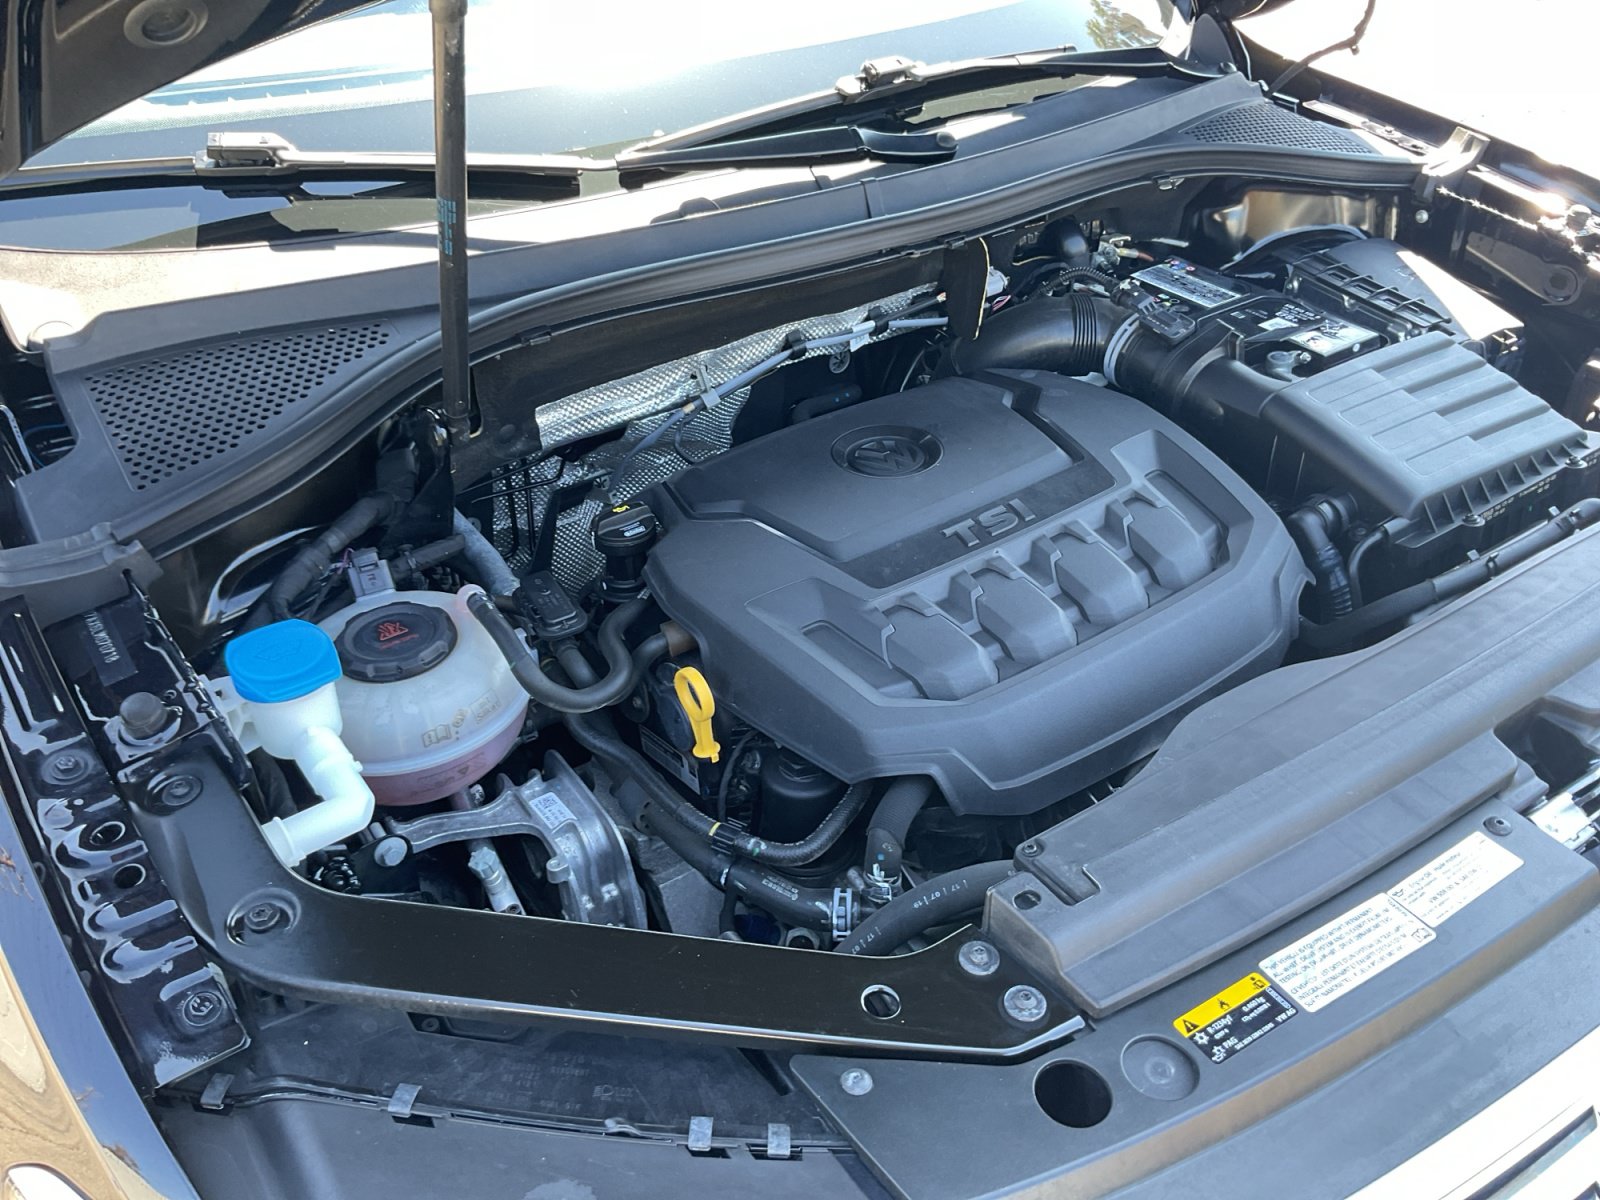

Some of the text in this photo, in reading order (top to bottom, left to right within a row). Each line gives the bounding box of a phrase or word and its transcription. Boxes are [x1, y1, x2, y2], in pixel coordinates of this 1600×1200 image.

[939, 498, 1036, 548] TSI
[1276, 1008, 1296, 1022] VW AG
[1222, 1037, 1237, 1047] PAG
